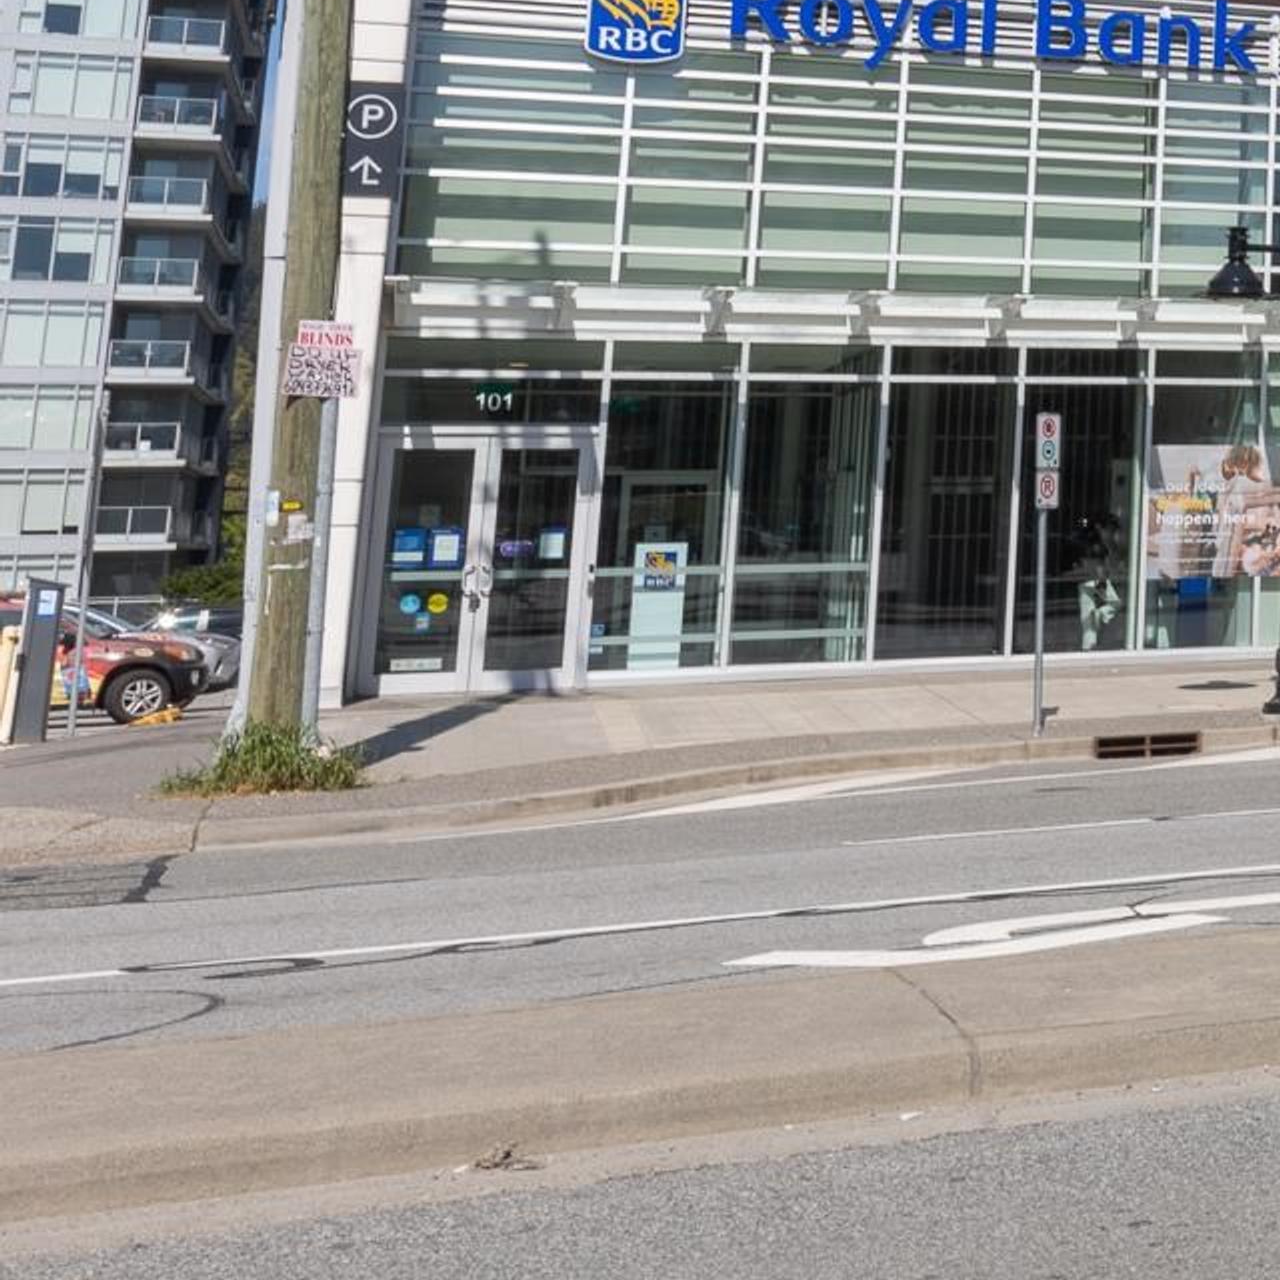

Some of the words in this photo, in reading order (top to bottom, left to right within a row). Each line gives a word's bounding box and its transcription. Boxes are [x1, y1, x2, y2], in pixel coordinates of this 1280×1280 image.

[597, 27, 673, 56] RBC
[300, 331, 353, 346] BLINDS
[476, 392, 513, 412] 101
[1156, 512, 1218, 529] happens
